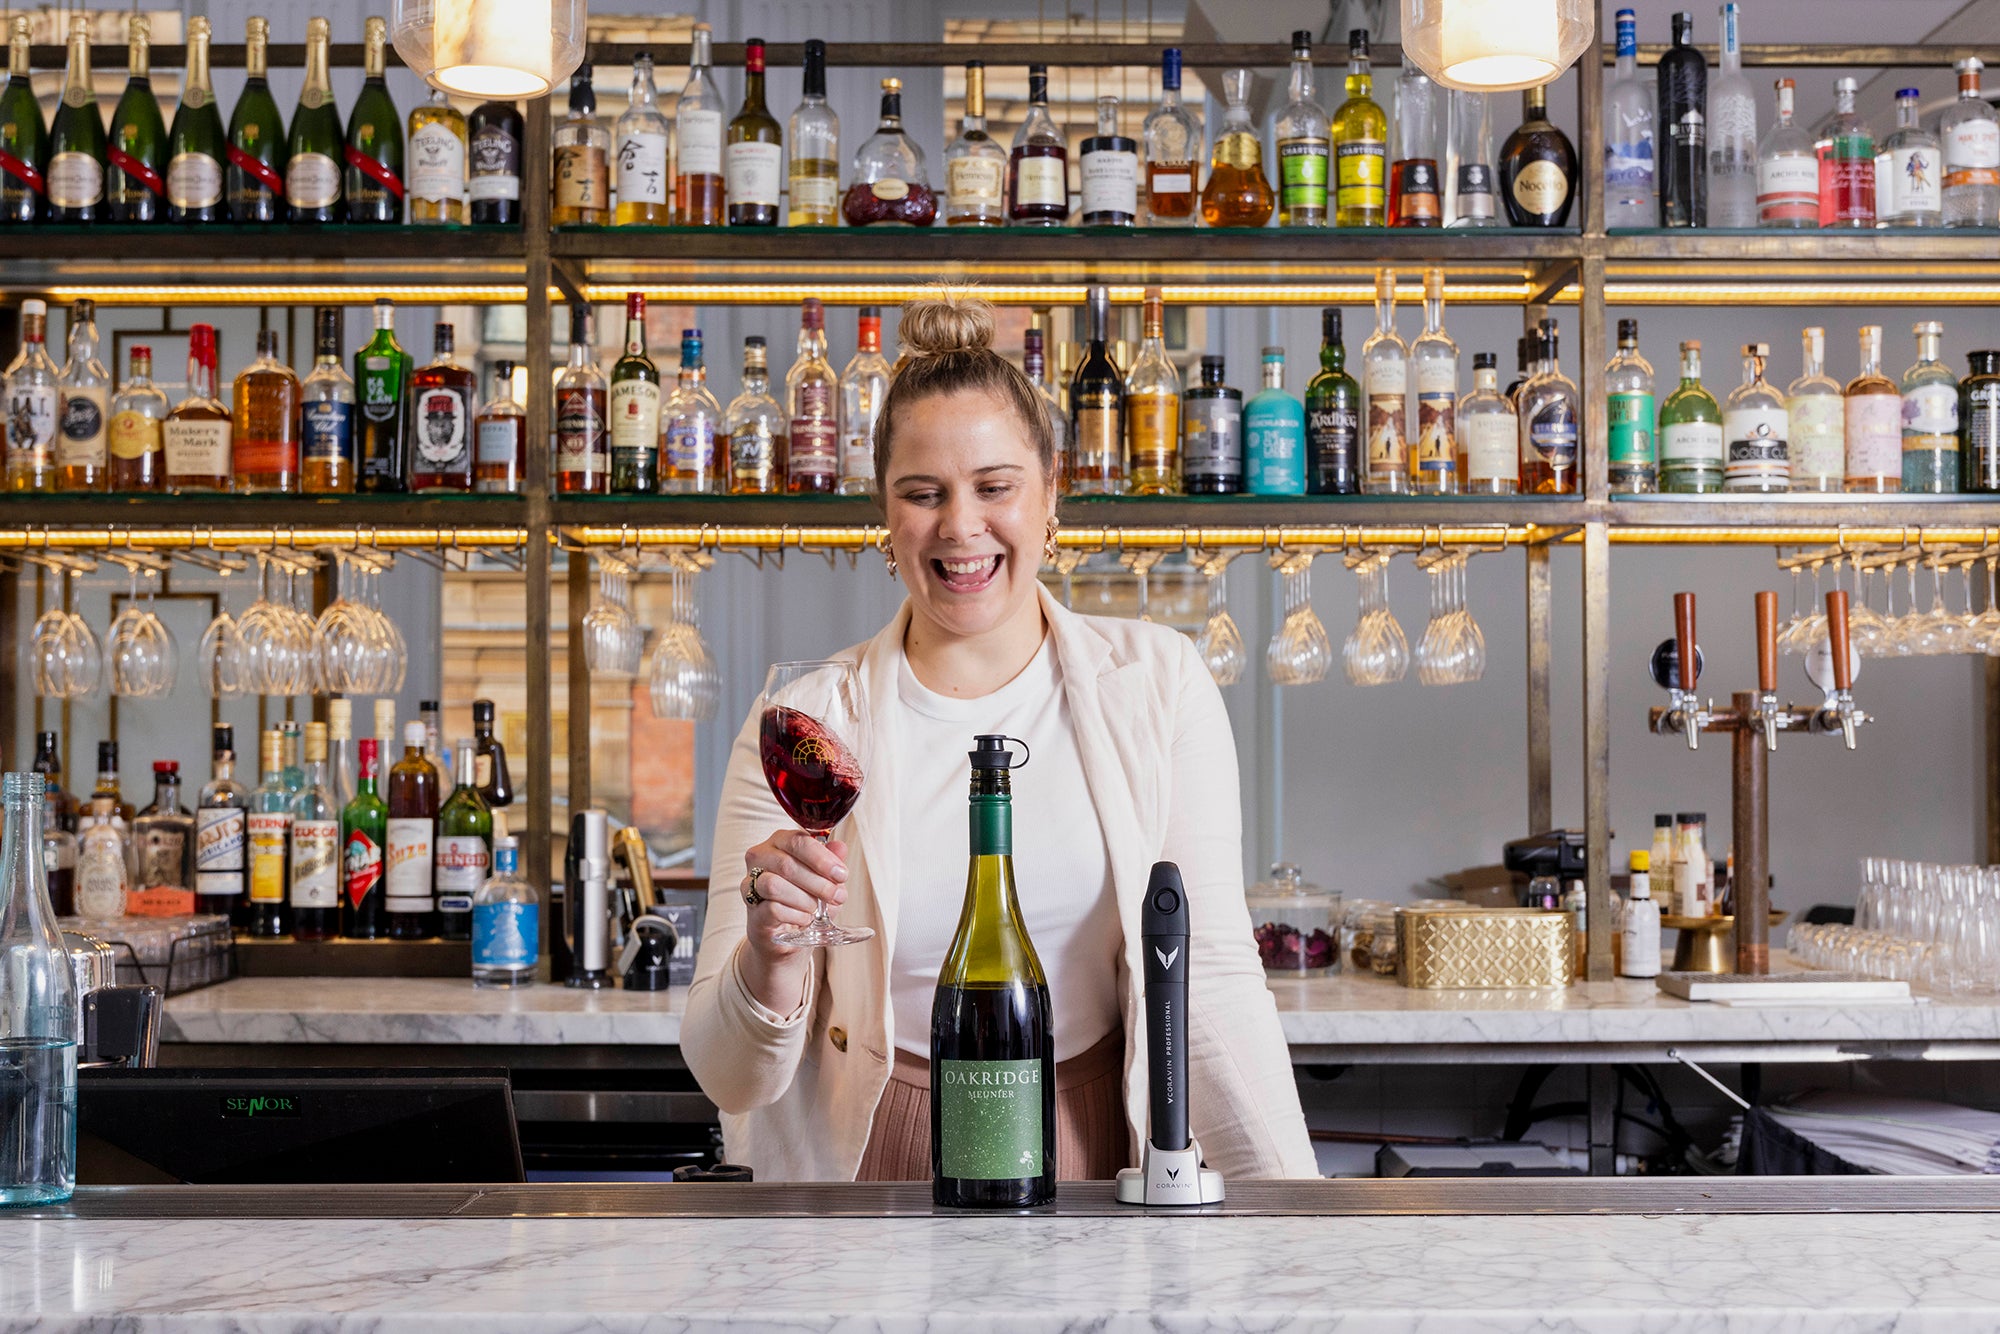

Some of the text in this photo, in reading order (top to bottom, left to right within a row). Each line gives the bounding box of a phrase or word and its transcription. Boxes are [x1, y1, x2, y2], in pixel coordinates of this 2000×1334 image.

[1519, 180, 1562, 192] Noceo
[614, 385, 658, 399] AMESON
[437, 852, 489, 867] ERNOD
[1164, 1000, 1174, 1098] CORAVIN PROFESSIONAL
[945, 1069, 1039, 1085] OAKRIDGE
[968, 1089, 1015, 1099] MEUNIER
